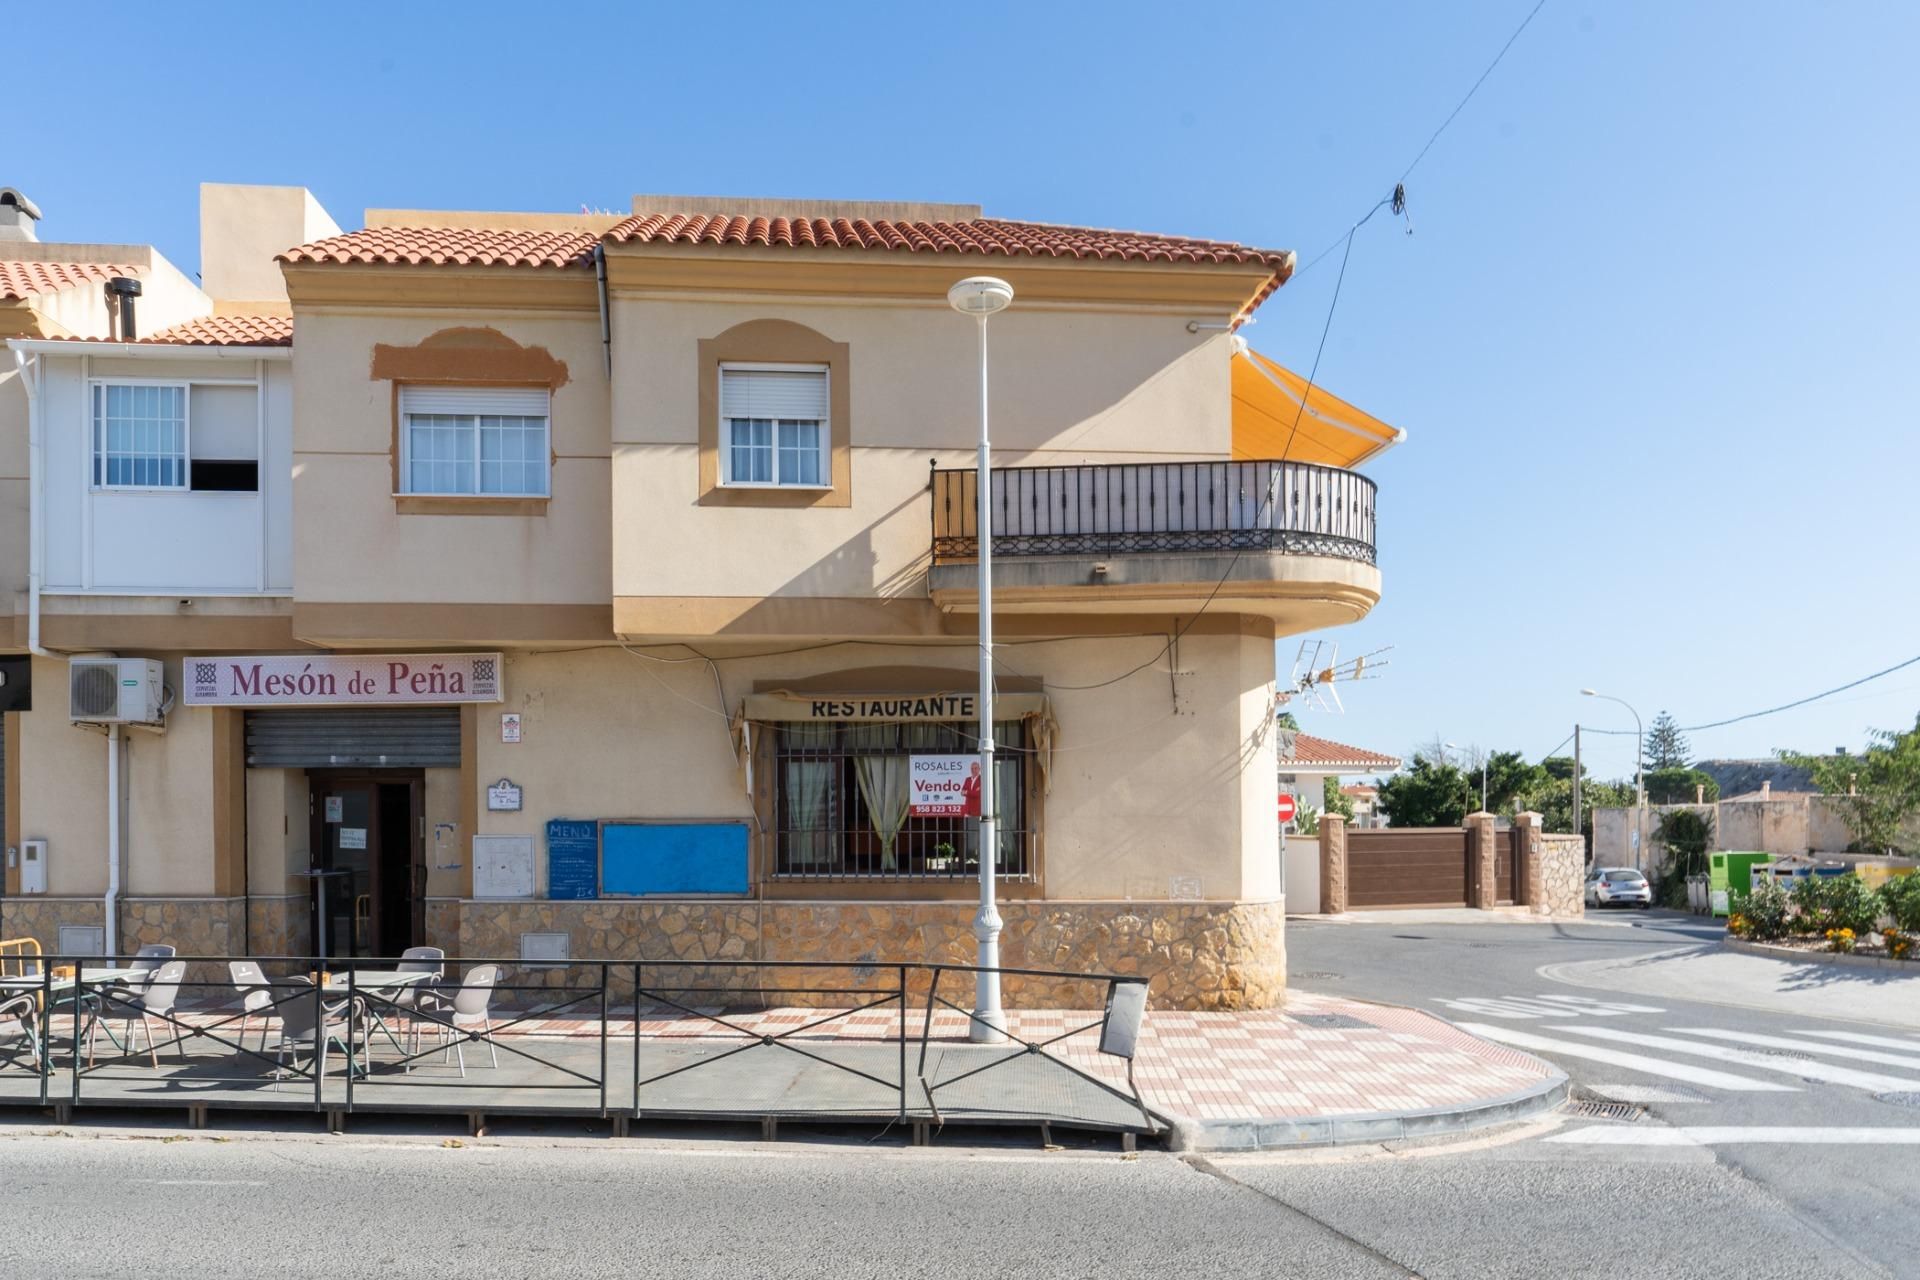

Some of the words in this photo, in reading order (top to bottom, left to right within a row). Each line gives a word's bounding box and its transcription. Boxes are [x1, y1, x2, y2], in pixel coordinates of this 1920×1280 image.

[230, 663, 337, 696] Mesón
[347, 670, 376, 695] de
[387, 662, 465, 694] Peña
[811, 697, 974, 717] RESTAURANTE
[914, 762, 963, 771] ROSALES
[914, 779, 961, 792] Vendo
[916, 805, 930, 813] 958
[932, 805, 946, 813] 823
[948, 805, 961, 813] 132
